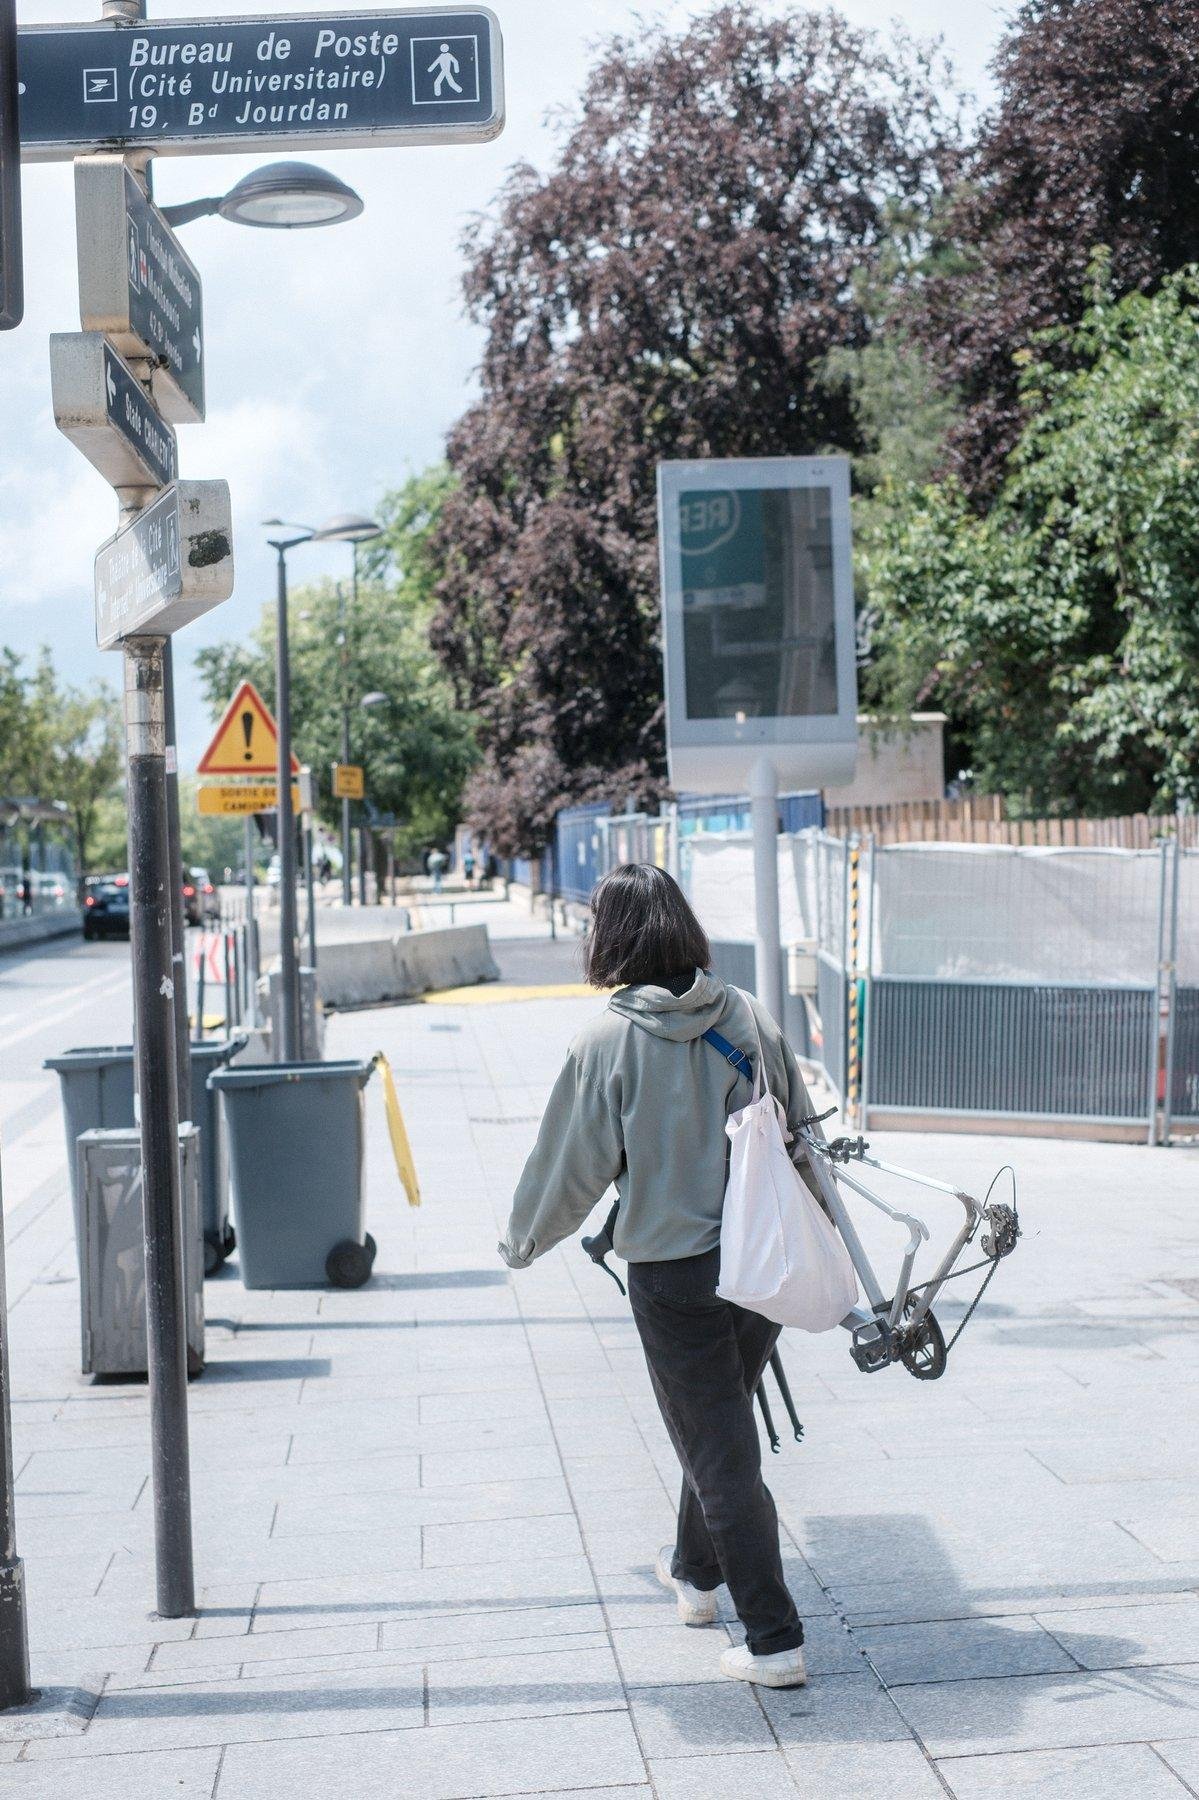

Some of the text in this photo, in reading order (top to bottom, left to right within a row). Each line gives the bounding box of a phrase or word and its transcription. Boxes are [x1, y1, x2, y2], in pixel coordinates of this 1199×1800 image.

[129, 30, 399, 67] Bureau de Poste
[129, 56, 385, 100] (Cité Universitaire)
[188, 102, 218, 126] Bd
[235, 98, 348, 124] Jourdan
[126, 392, 141, 436] Stade
[149, 517, 162, 555] Cité
